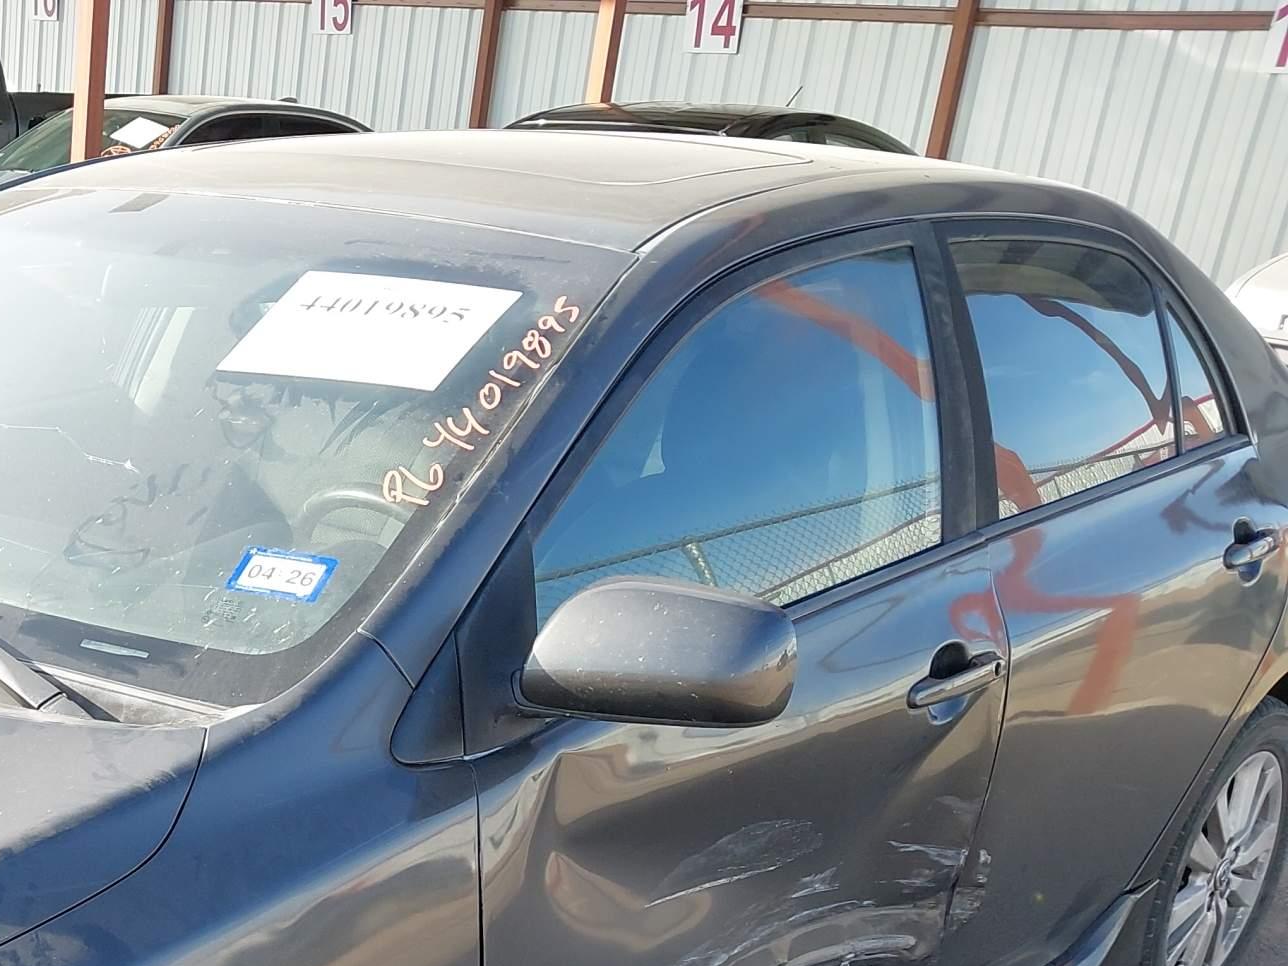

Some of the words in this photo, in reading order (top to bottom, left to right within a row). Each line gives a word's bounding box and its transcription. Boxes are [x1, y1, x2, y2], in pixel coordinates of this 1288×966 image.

[320, 0, 349, 31] 15
[690, 0, 736, 48] 14
[422, 295, 579, 451] 44019895
[247, 564, 277, 580] 04
[284, 568, 317, 587] 26
